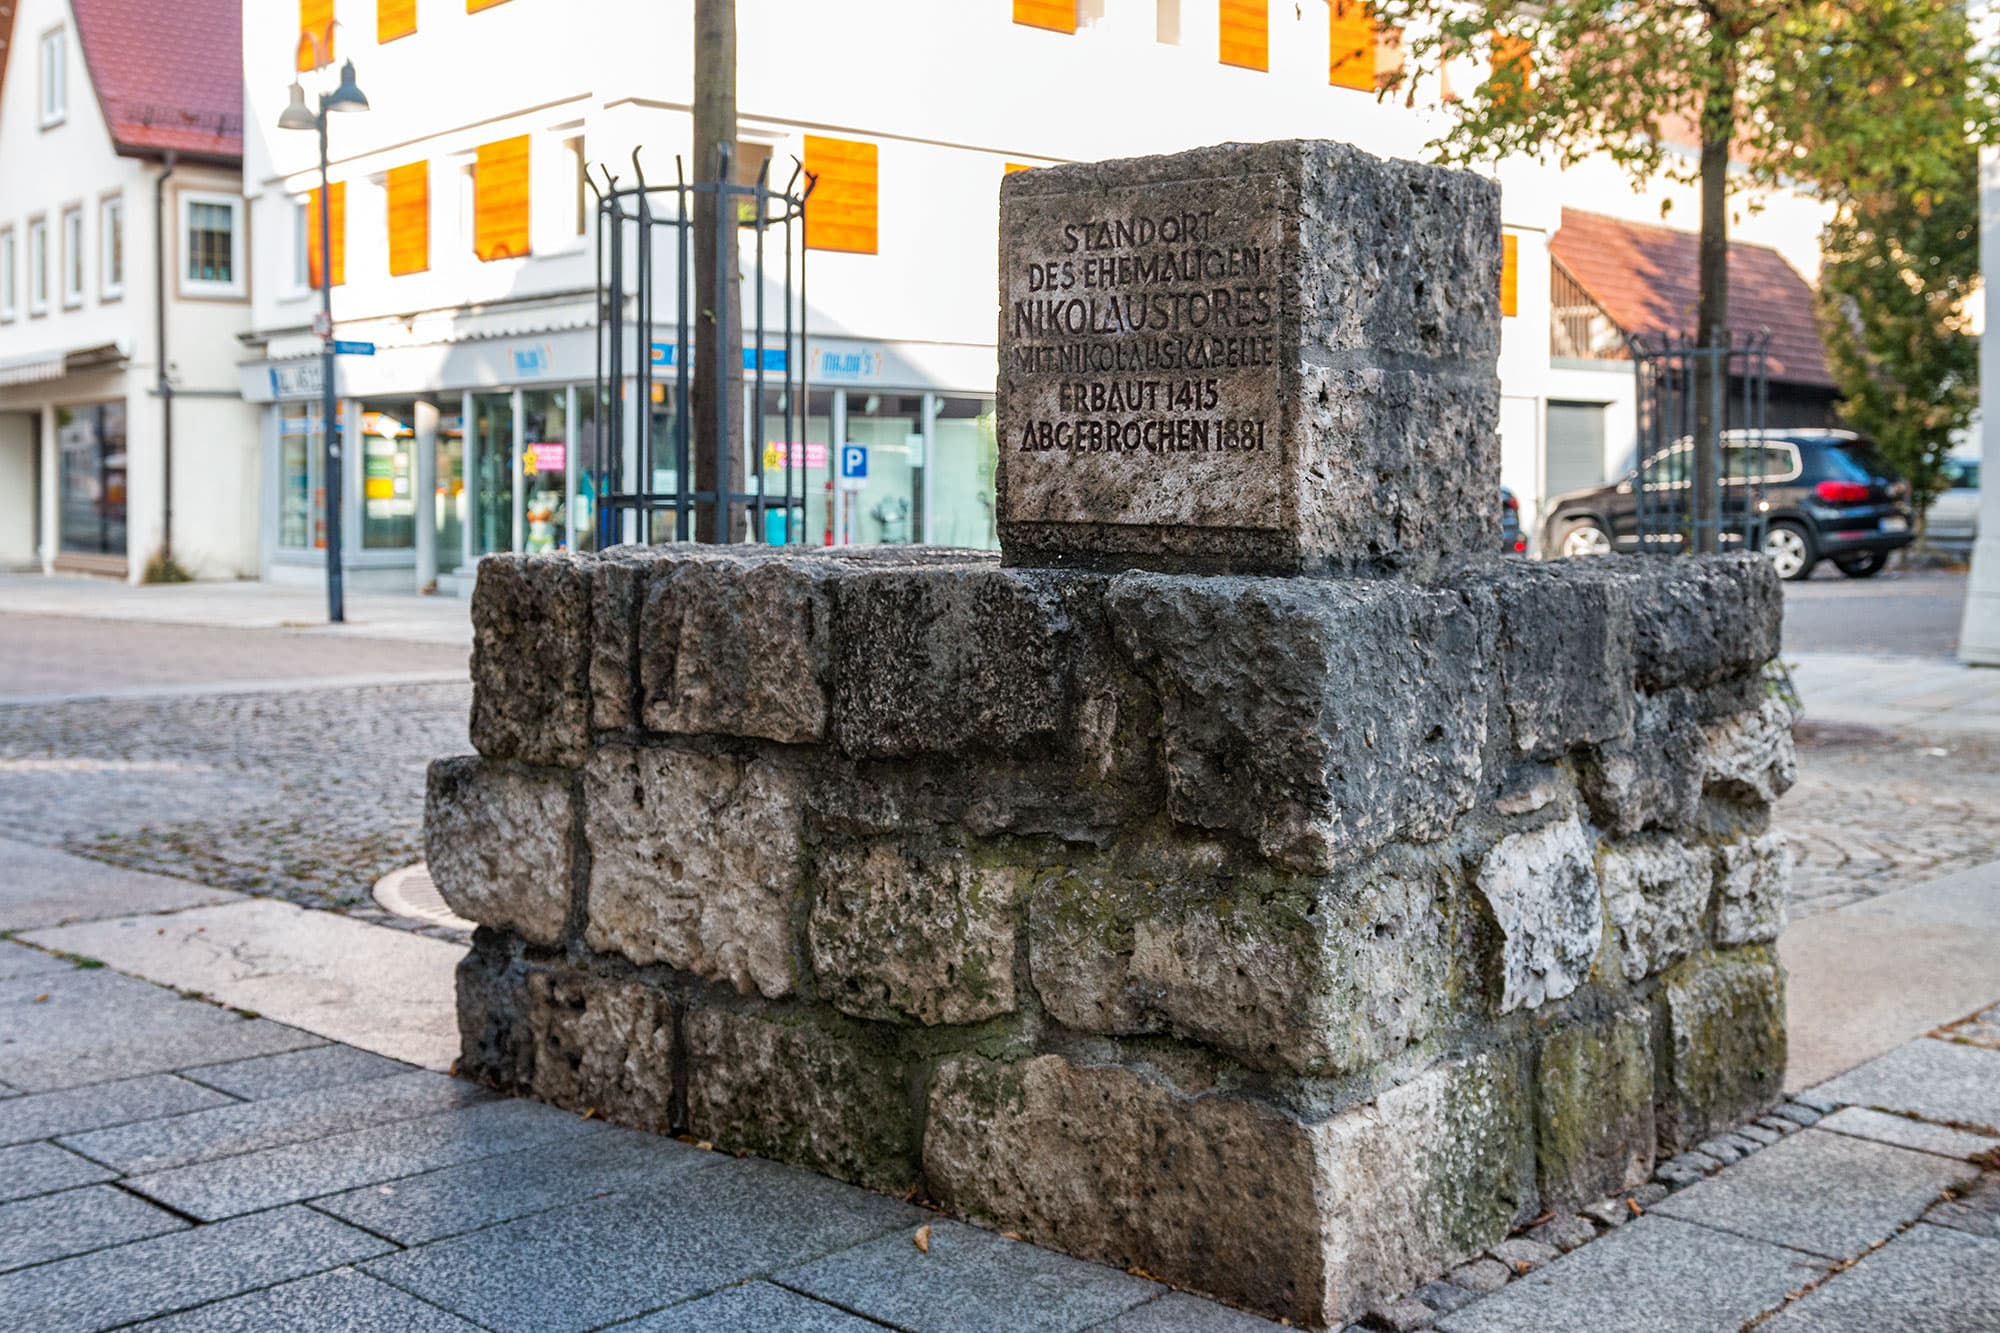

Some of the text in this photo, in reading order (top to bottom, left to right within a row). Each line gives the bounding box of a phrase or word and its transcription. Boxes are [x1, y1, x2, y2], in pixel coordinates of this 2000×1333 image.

[1063, 210, 1215, 252] STANDORT
[1028, 246, 1261, 292] DES EHEMALIGEN
[1013, 286, 1273, 338] NIKOLAUSTORES
[1058, 378, 1219, 413] ERBAUT 1415
[1019, 419, 1266, 452] ABGEBROCHEN 1881
[847, 448, 864, 475] P
